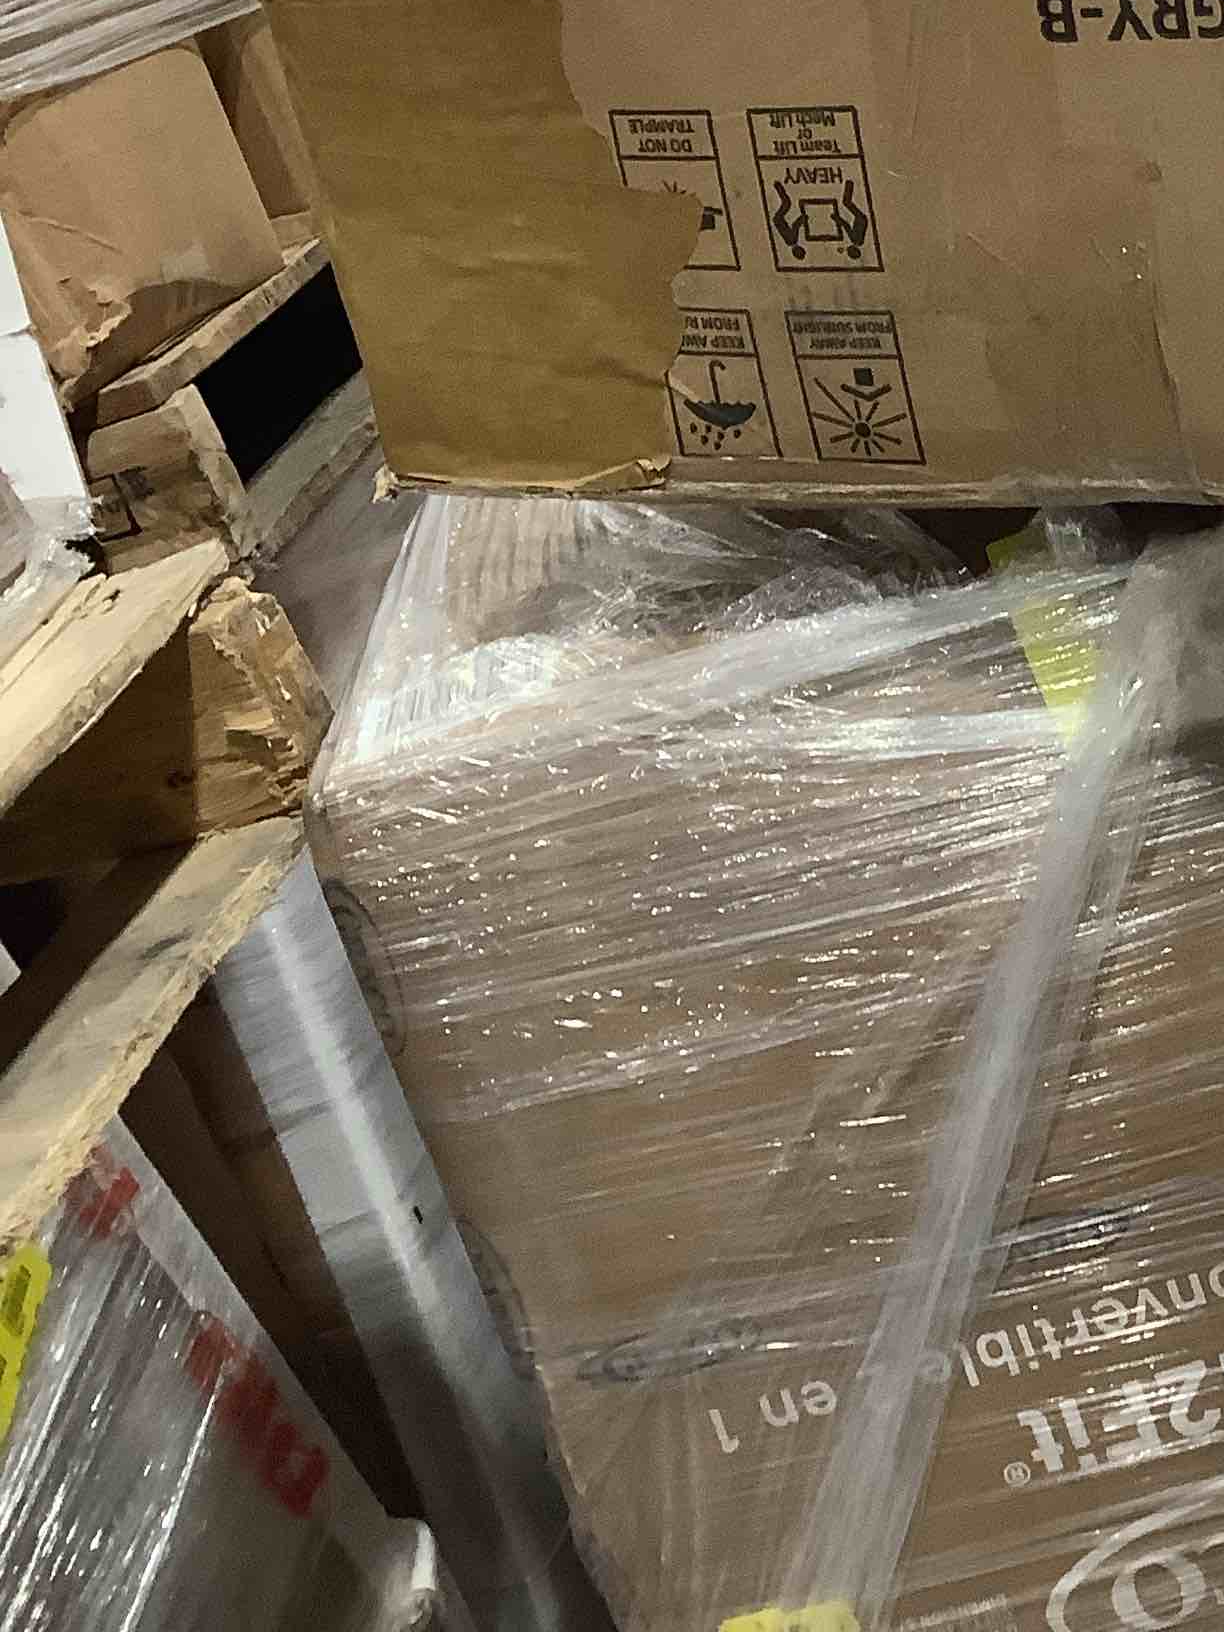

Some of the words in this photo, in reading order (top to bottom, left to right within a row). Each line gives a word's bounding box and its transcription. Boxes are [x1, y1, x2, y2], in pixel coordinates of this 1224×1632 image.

[628, 118, 695, 135] TRAMPLE
[637, 138, 668, 153] NOT
[671, 139, 692, 153] DO
[772, 140, 798, 156] Lift
[800, 139, 842, 154] Team
[783, 167, 844, 185] HEAVY
[702, 317, 741, 332] FROM
[856, 320, 895, 335] FROM
[710, 335, 746, 349] KEEP
[851, 337, 882, 350] KEEP
[759, 1380, 838, 1428] en
[708, 1408, 740, 1454] 1
